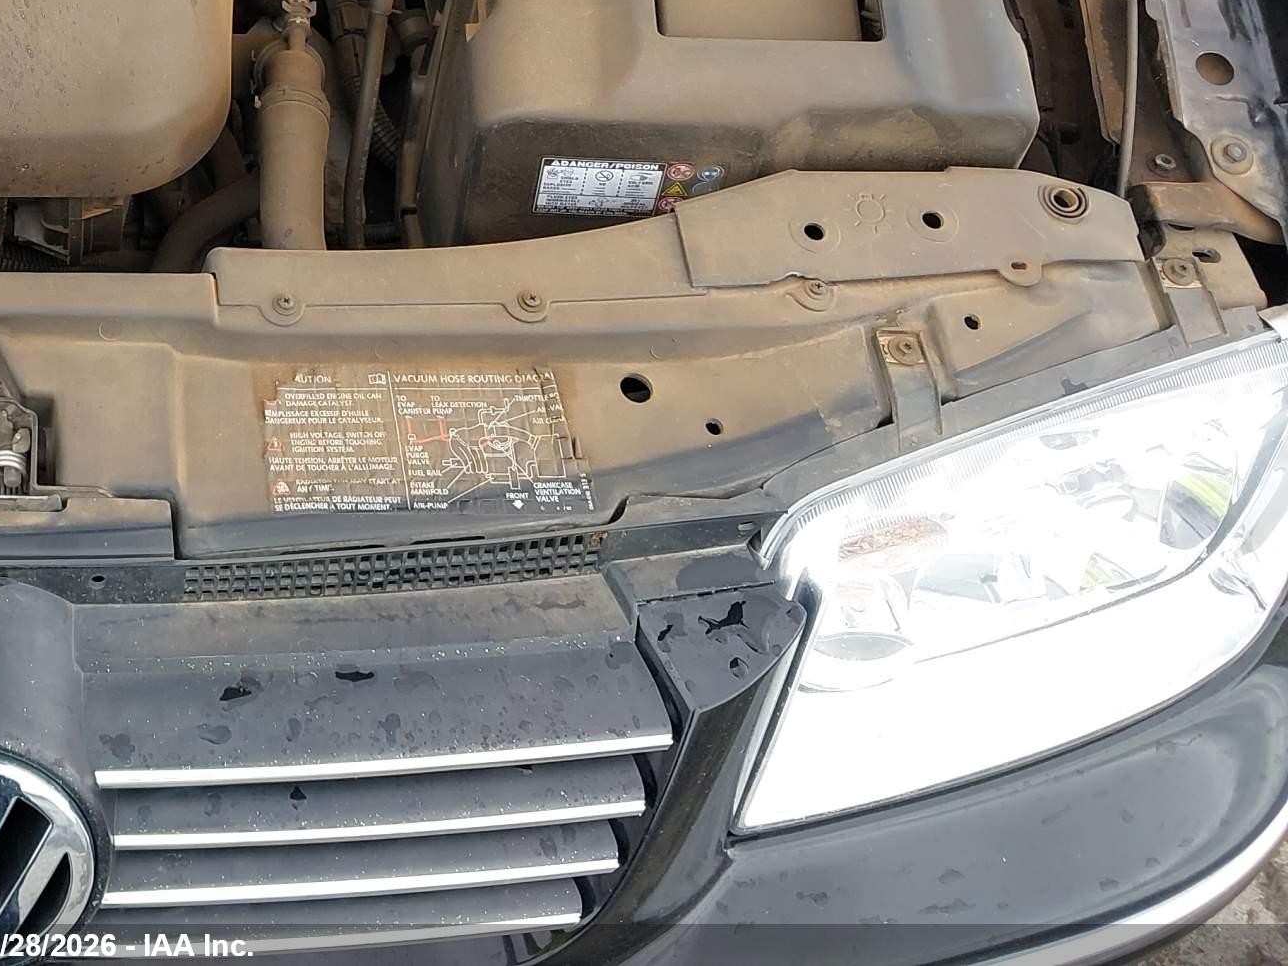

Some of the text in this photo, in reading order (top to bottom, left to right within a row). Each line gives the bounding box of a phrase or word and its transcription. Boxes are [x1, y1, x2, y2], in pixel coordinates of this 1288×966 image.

[561, 160, 659, 171] DANGER/POISON
[294, 373, 332, 384] AUTION
[393, 374, 438, 383] VACUUM
[440, 374, 466, 383] HOSE
[468, 374, 512, 383] ROUTING
[533, 481, 573, 489] CRANKCASE
[534, 488, 581, 496] VENTILATION
